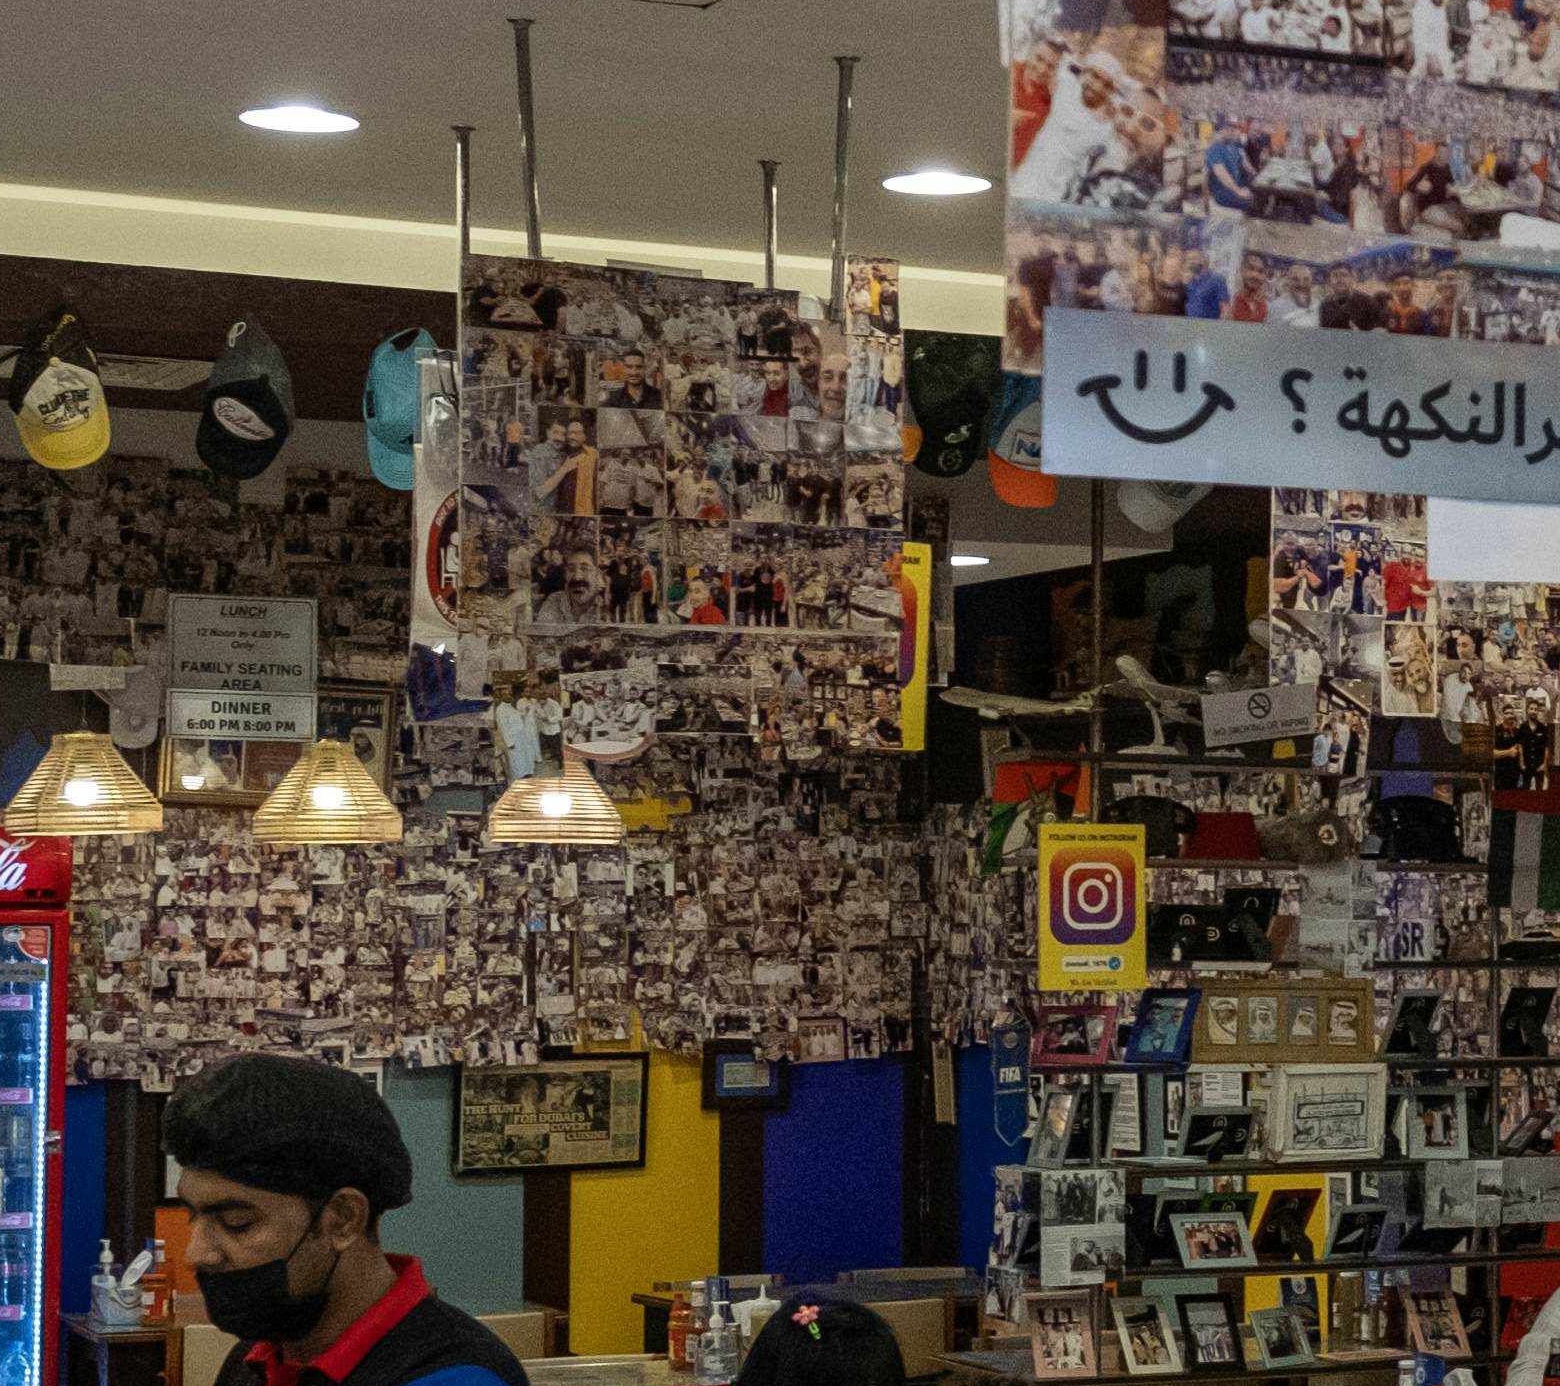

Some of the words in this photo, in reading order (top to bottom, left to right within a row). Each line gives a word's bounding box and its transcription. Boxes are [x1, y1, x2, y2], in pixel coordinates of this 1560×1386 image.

[220, 605, 269, 619] LUNCH
[180, 661, 233, 674] FAMILY
[237, 663, 303, 676] SEATING
[220, 679, 262, 691] AREA
[211, 700, 272, 715] DINNER
[187, 718, 216, 731] 6:00
[218, 719, 240, 732] PM
[242, 719, 272, 732] 8:00
[274, 720, 296, 733] PM
